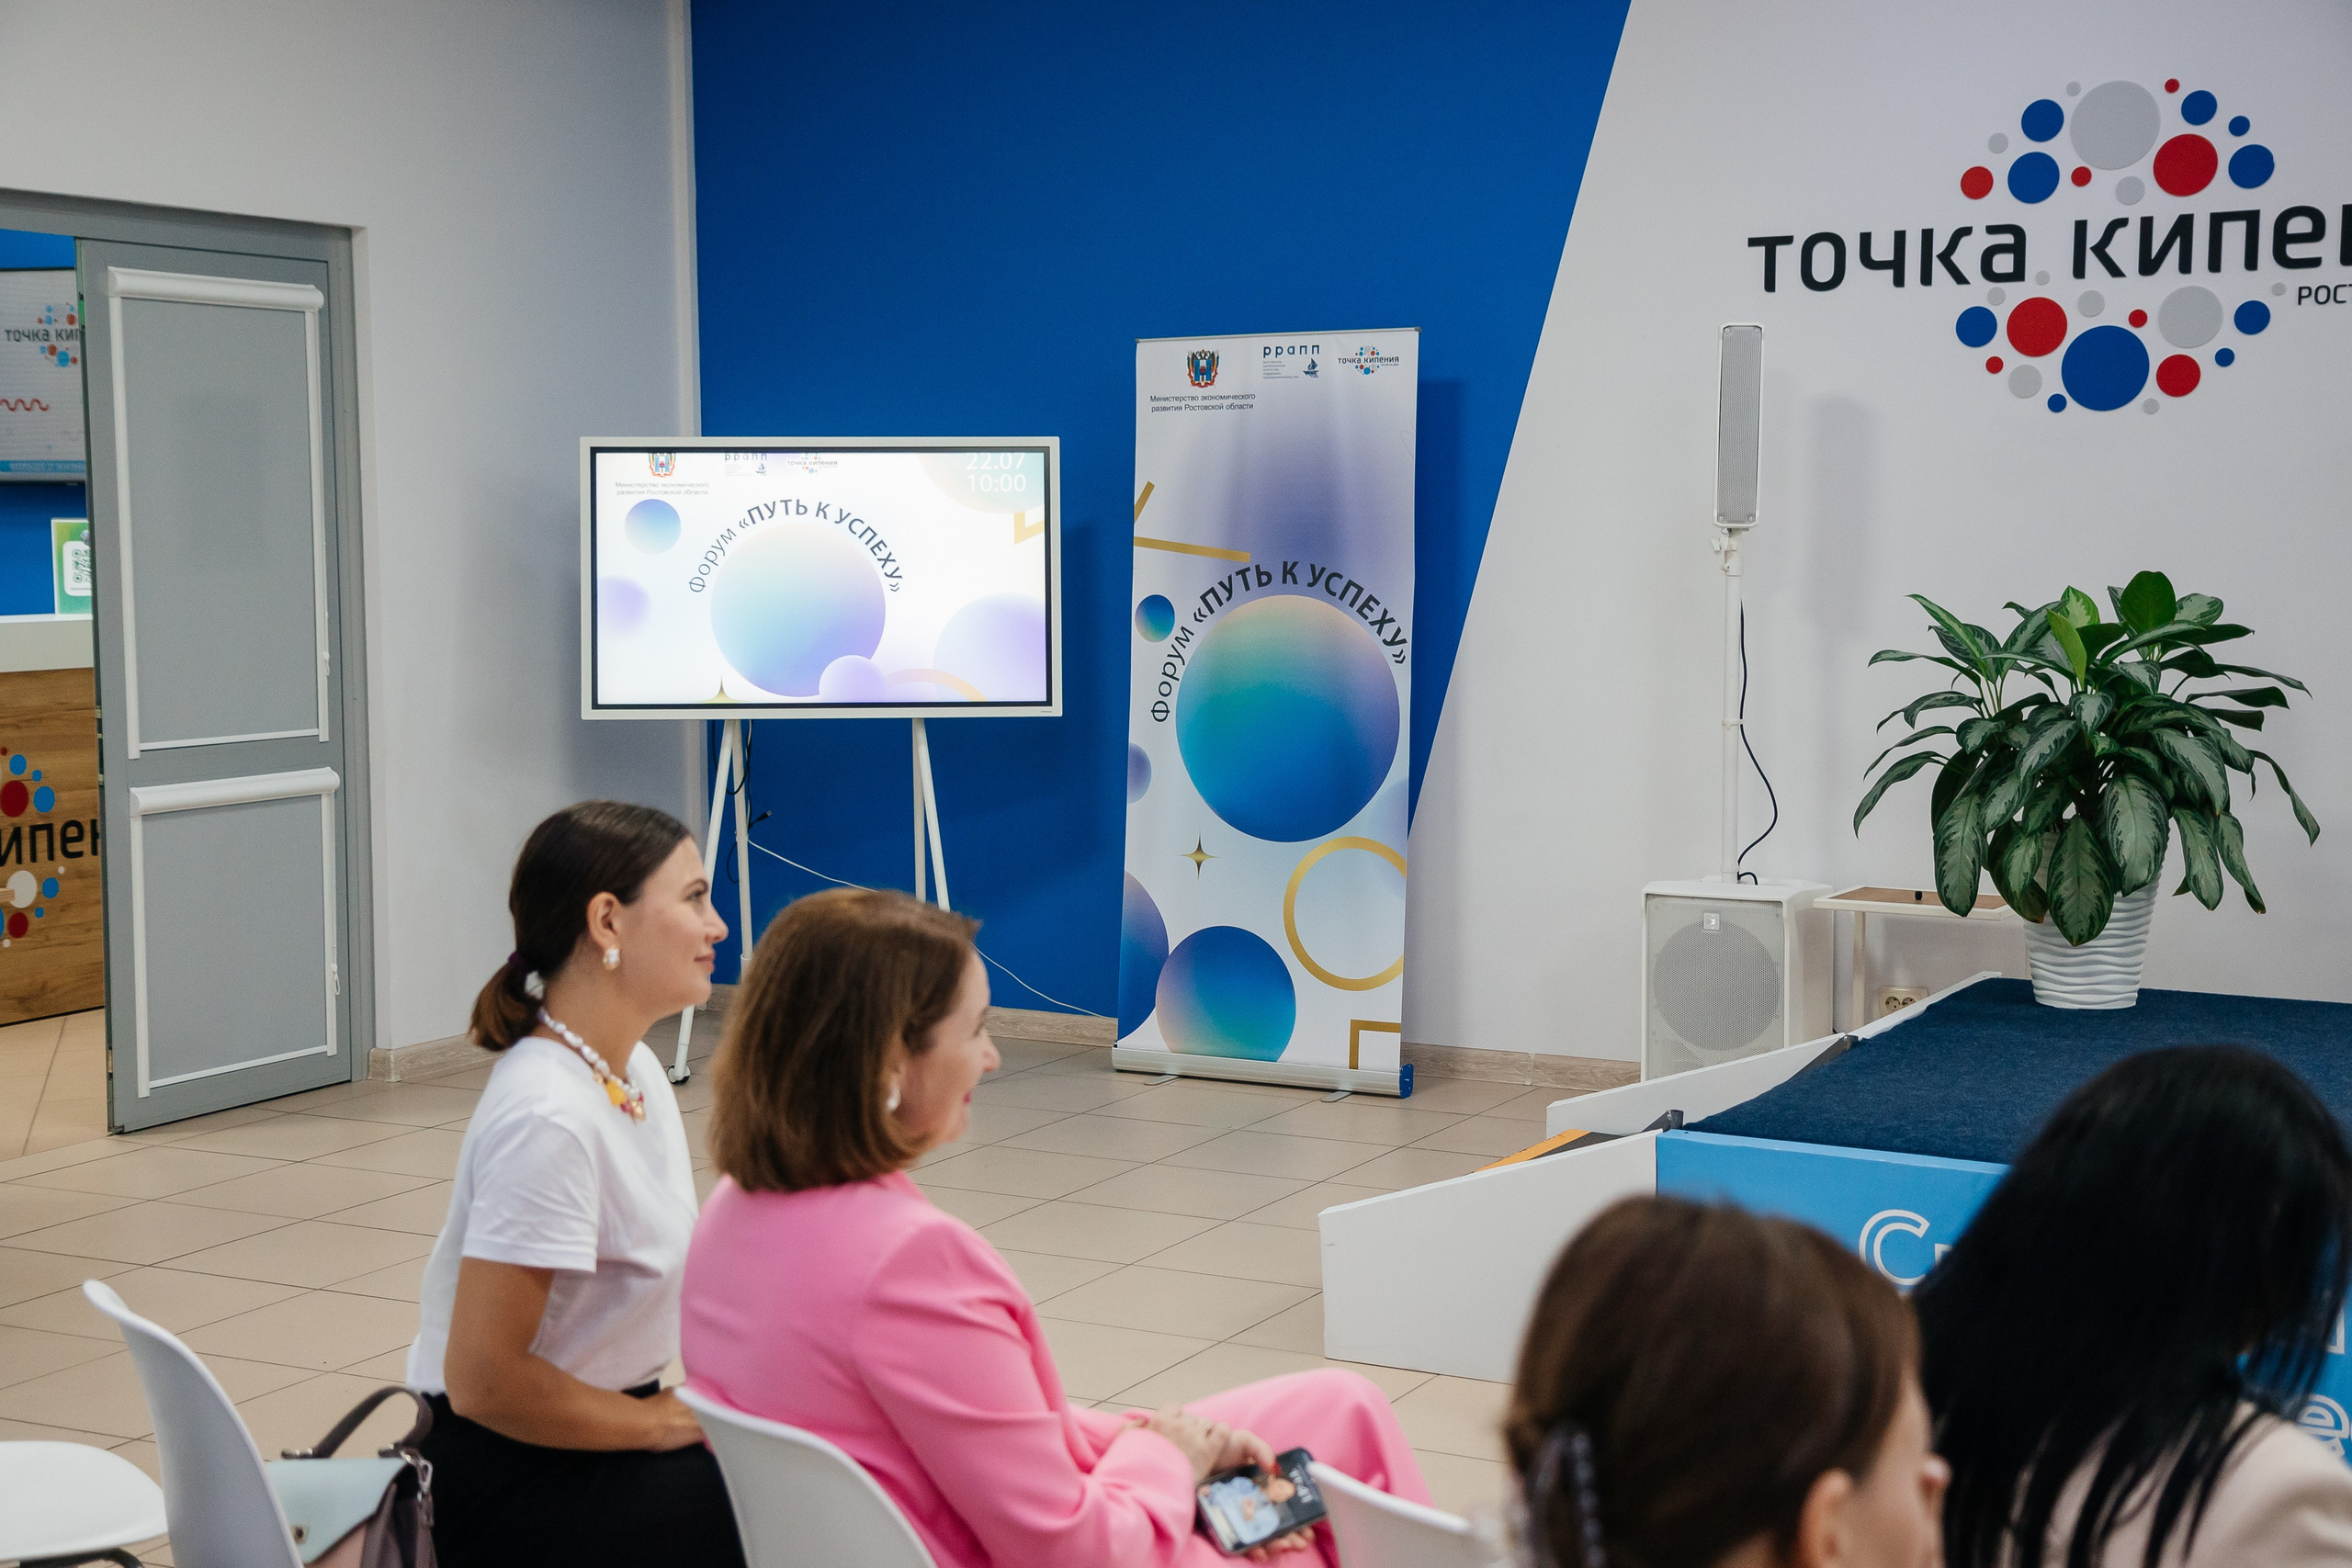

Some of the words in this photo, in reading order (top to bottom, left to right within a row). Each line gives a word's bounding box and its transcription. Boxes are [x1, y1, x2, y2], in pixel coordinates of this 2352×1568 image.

[1747, 222, 2027, 293] точка
[2297, 283, 2352, 306] РОС
[5, 328, 51, 343] точка
[1363, 355, 1399, 364] кипения
[1149, 395, 1199, 403] Министерство
[1151, 405, 1183, 413] развития
[1184, 403, 1224, 412] Ростовской
[1225, 402, 1254, 411] области
[966, 452, 1026, 470] 22.07
[967, 473, 1027, 492] 10:00
[688, 527, 737, 593] Форум
[739, 499, 808, 529] «ПУТЬ
[815, 501, 831, 520] К
[834, 507, 904, 592] УСПЕХУ»
[1150, 625, 1195, 723] Форум
[1193, 563, 1273, 625] «ПУТЬ
[1282, 560, 1299, 585] К
[1306, 562, 1408, 665] УСПЕХУ»
